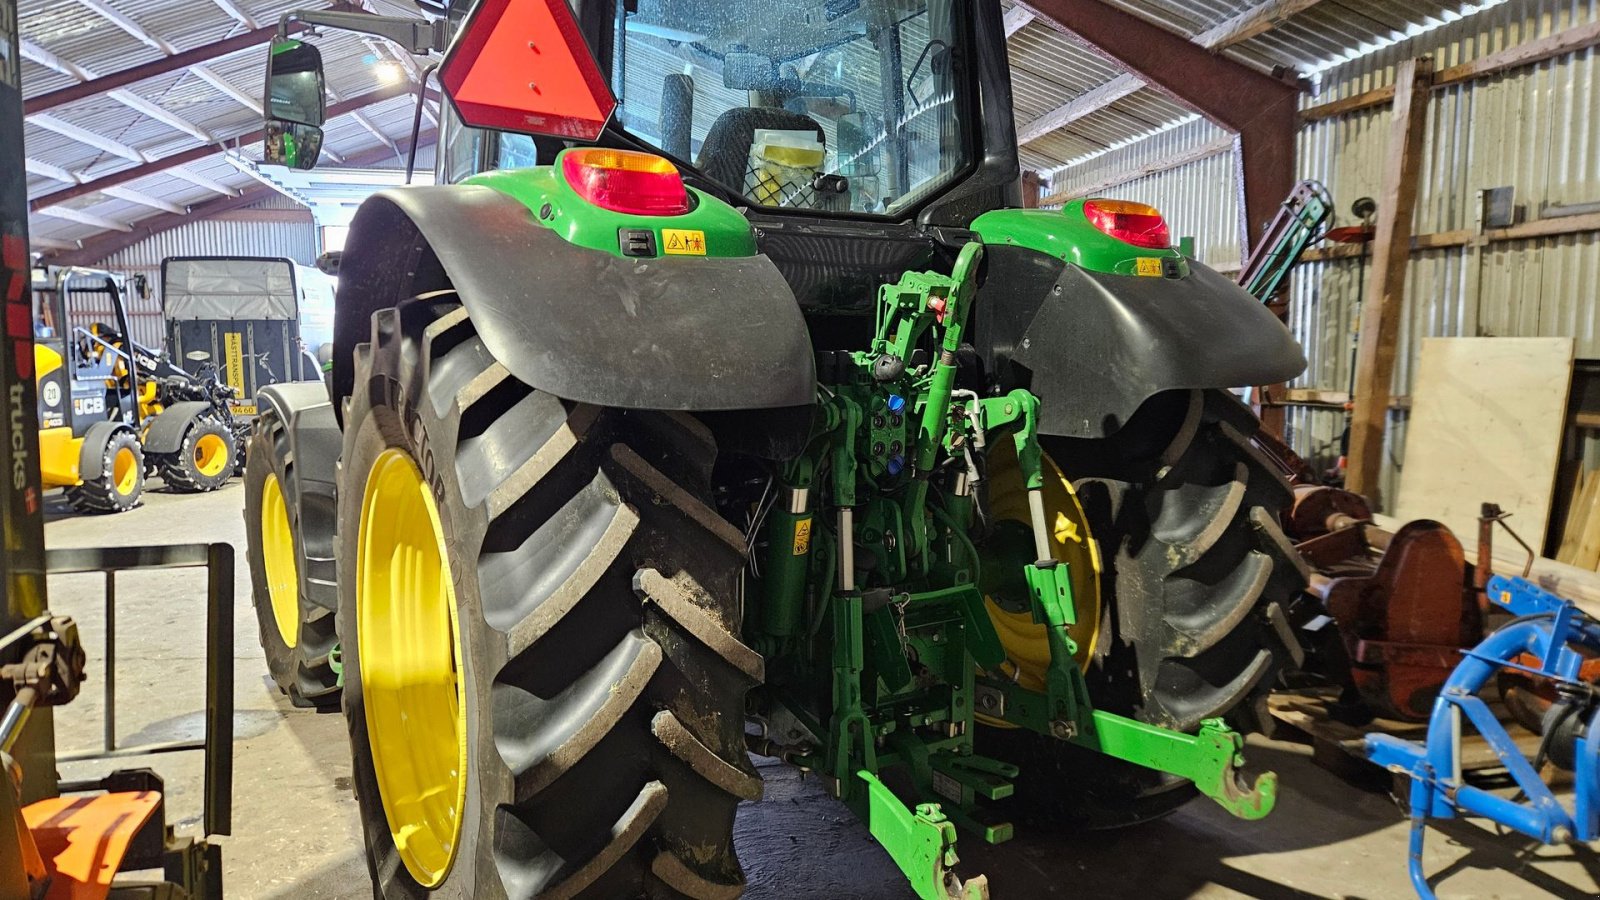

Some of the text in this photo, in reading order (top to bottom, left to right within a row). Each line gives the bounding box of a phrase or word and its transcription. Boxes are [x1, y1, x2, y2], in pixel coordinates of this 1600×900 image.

[47, 388, 57, 400] 20
[74, 397, 104, 416] JCB
[10, 382, 28, 490] trucks
